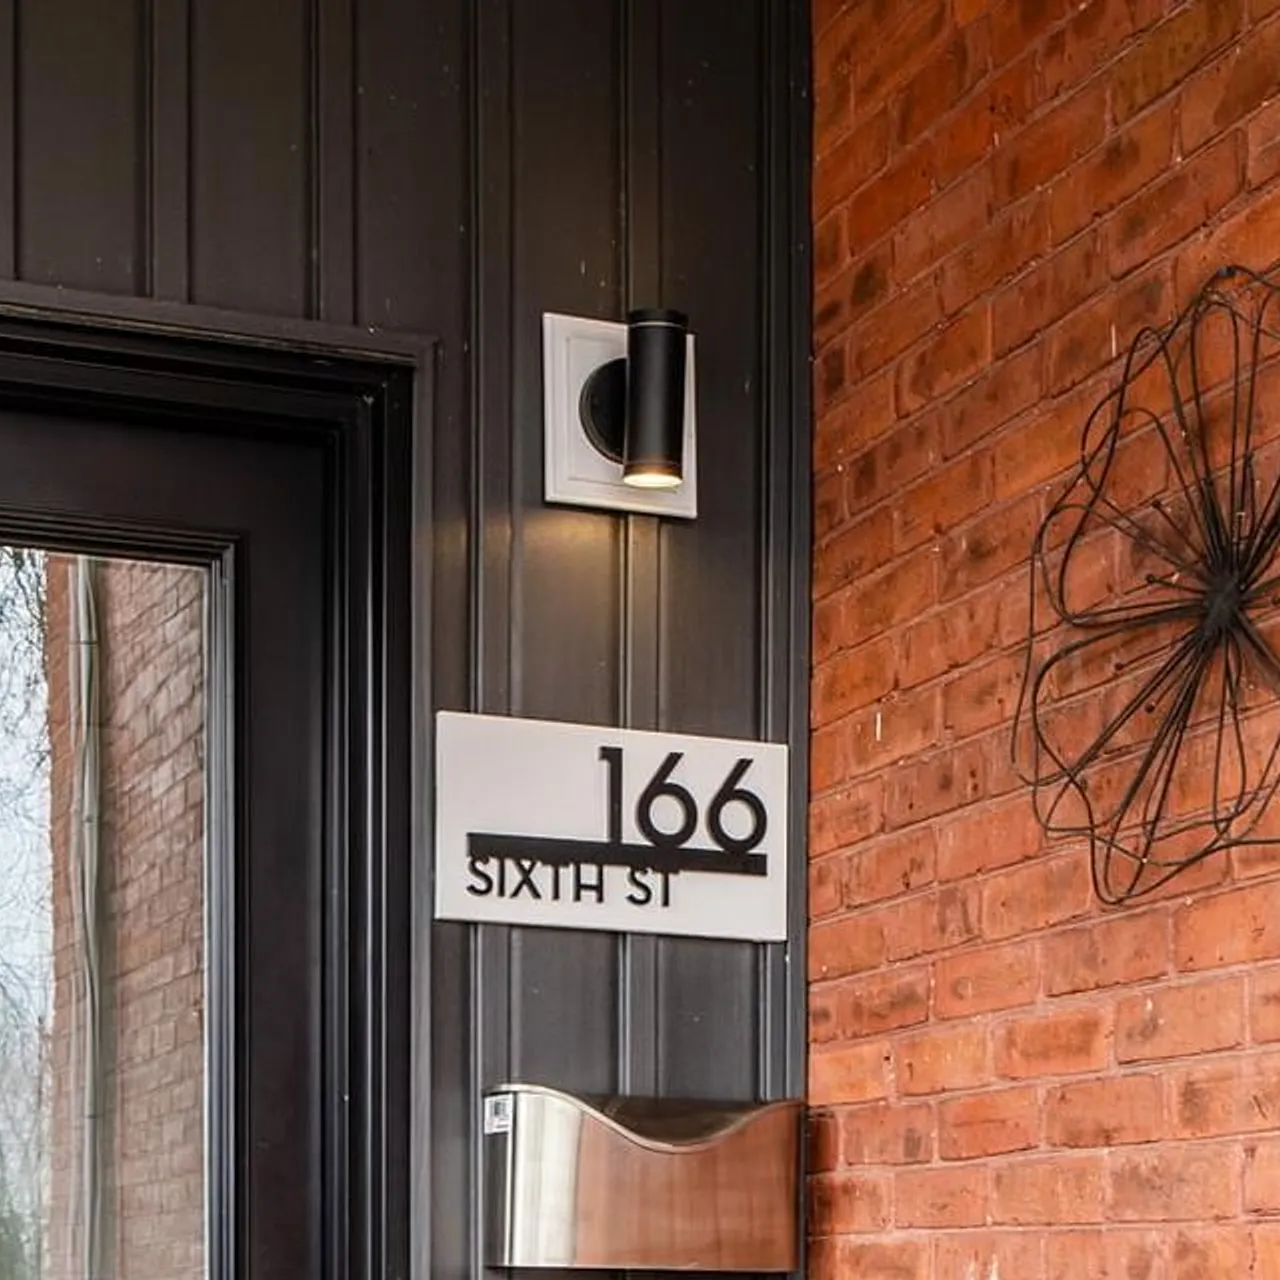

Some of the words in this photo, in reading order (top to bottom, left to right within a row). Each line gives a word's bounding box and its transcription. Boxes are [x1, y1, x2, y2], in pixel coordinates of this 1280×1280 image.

[598, 746, 768, 855] 166
[466, 855, 605, 904] SIXTH
[625, 865, 681, 908] ST
